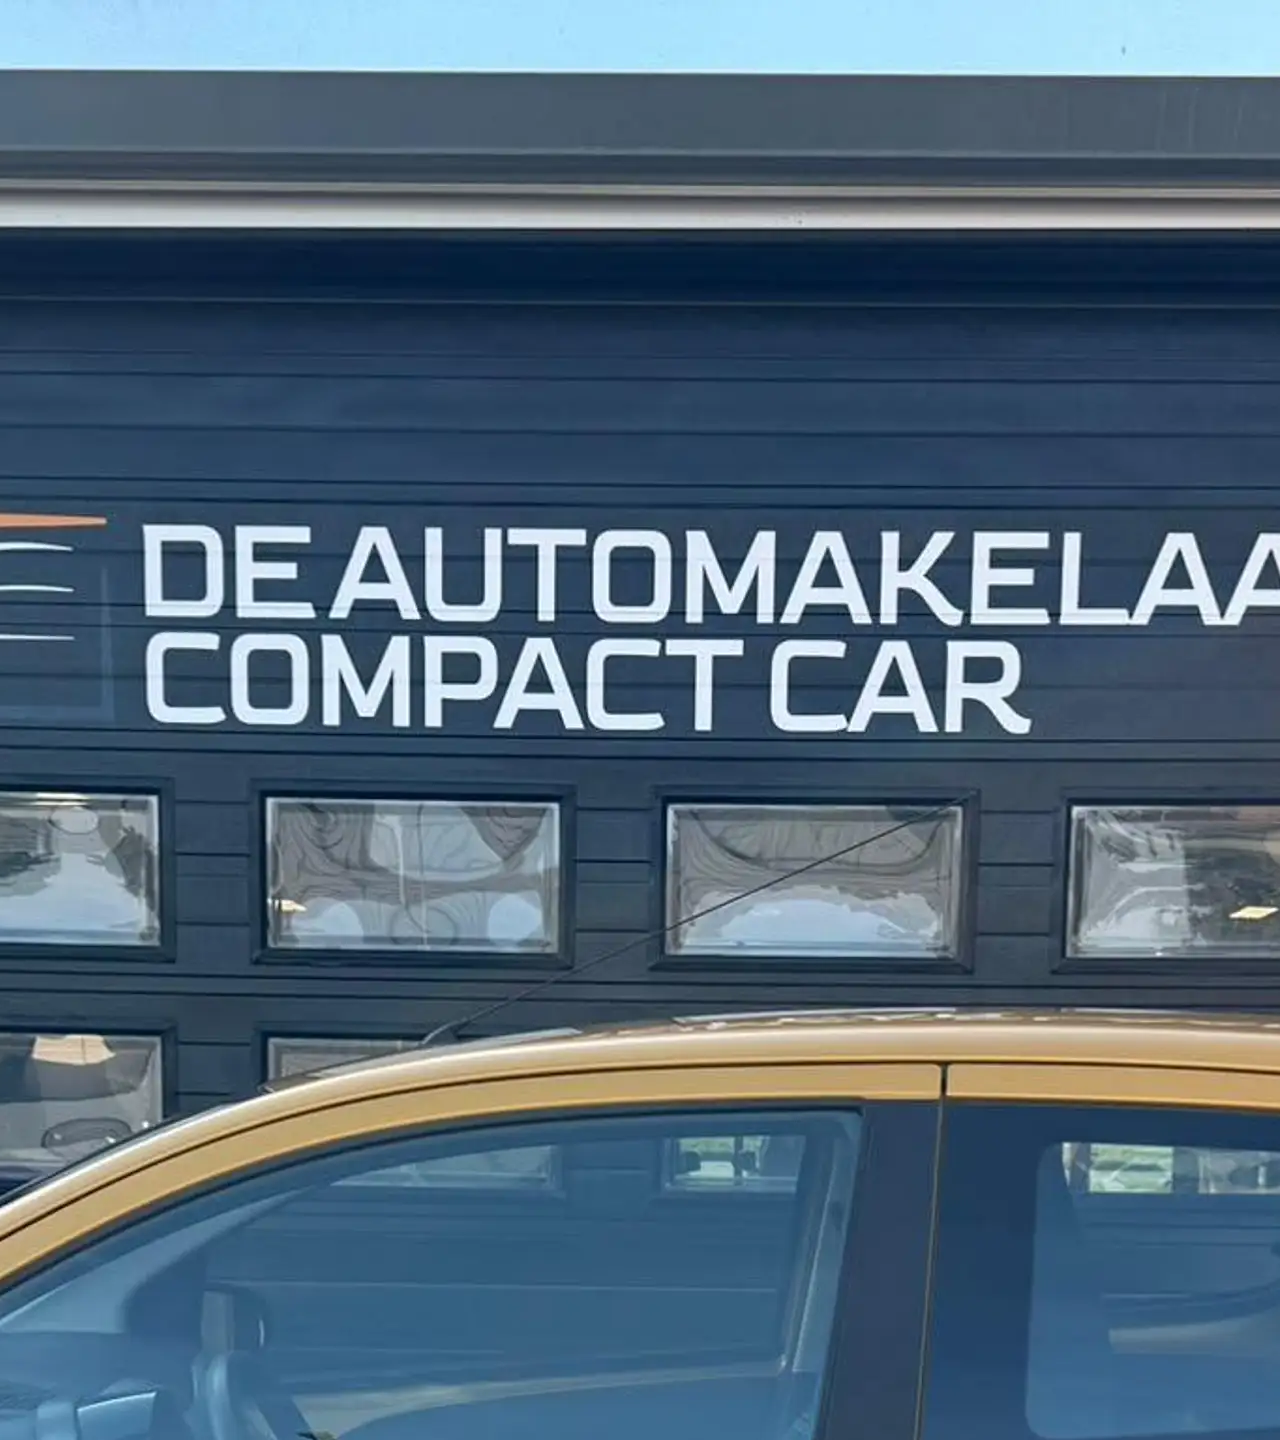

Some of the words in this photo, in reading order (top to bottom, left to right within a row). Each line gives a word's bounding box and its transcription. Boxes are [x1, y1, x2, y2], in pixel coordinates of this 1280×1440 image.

[142, 524, 317, 619] DE
[145, 631, 744, 731] COMPACT
[770, 639, 1032, 735] CAR
